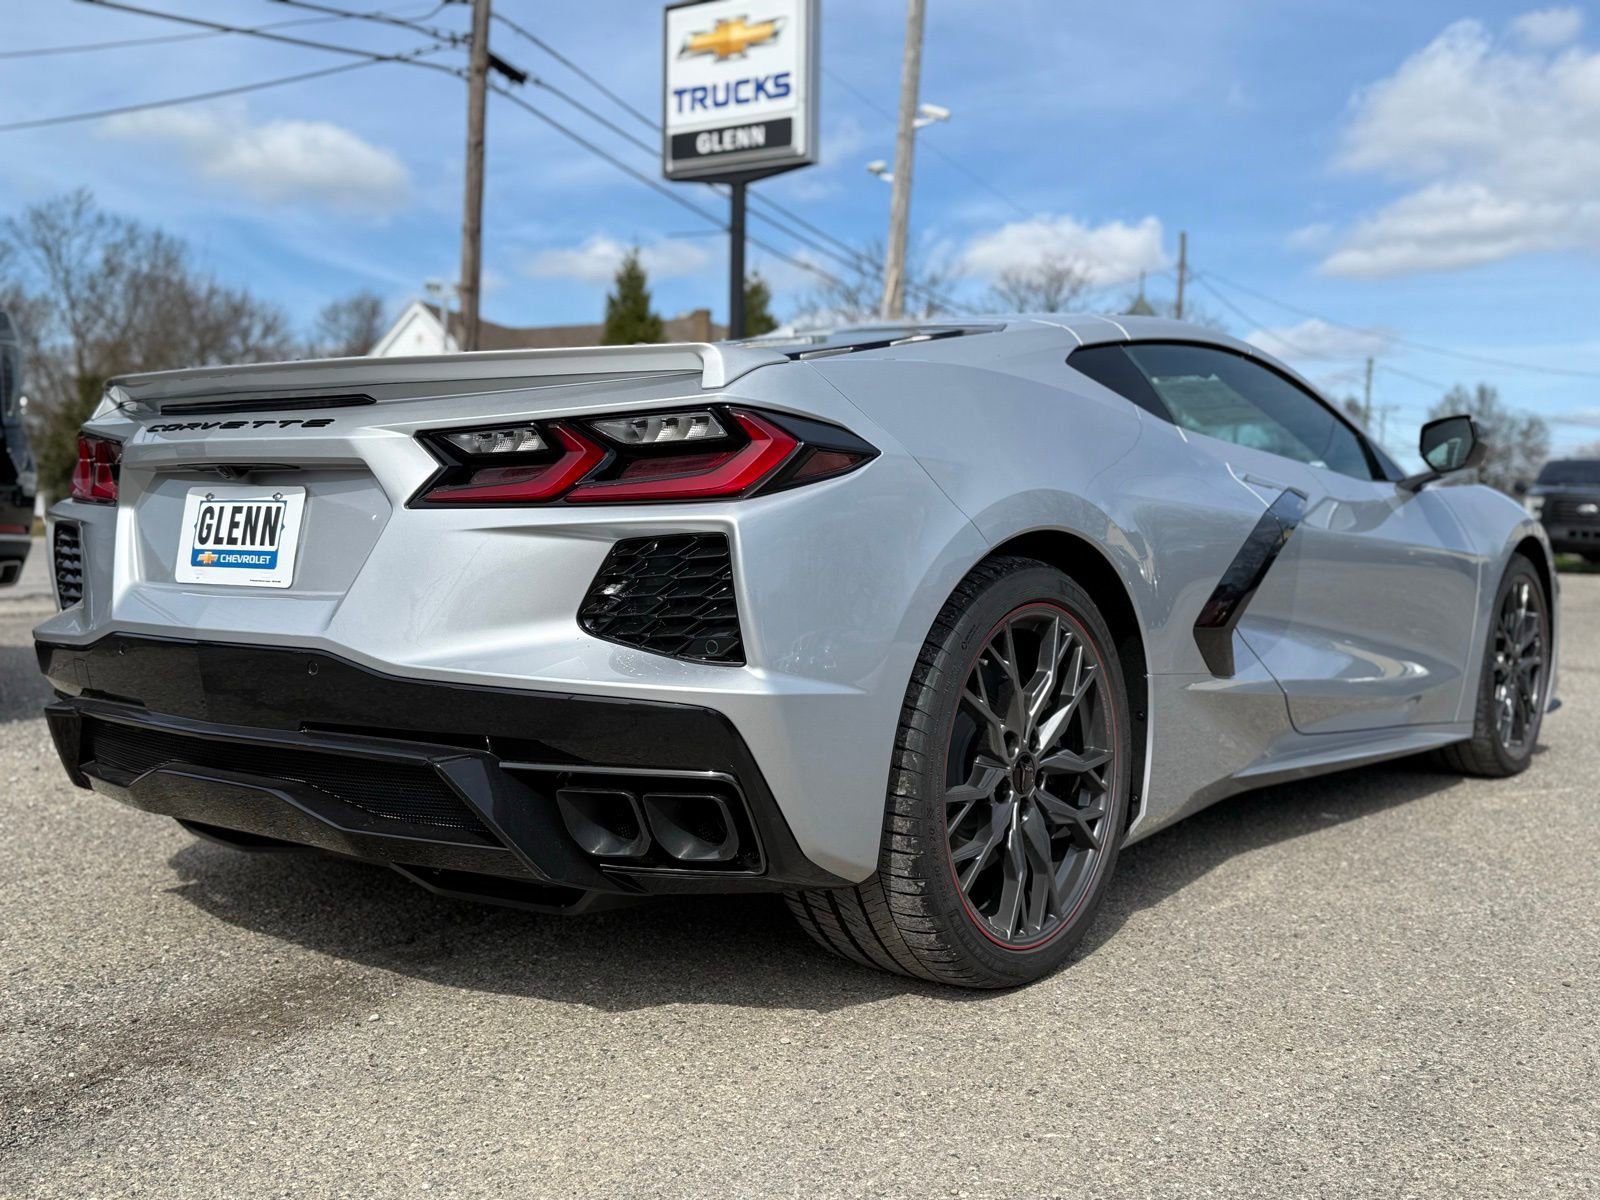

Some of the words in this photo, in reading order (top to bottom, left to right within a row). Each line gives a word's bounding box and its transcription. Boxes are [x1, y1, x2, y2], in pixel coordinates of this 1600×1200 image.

[674, 72, 791, 113] TRUCKS
[696, 125, 766, 154] GLENN
[147, 419, 335, 433] CORVETTE
[198, 506, 282, 546] GLENN
[220, 554, 272, 565] CHEVROLET
